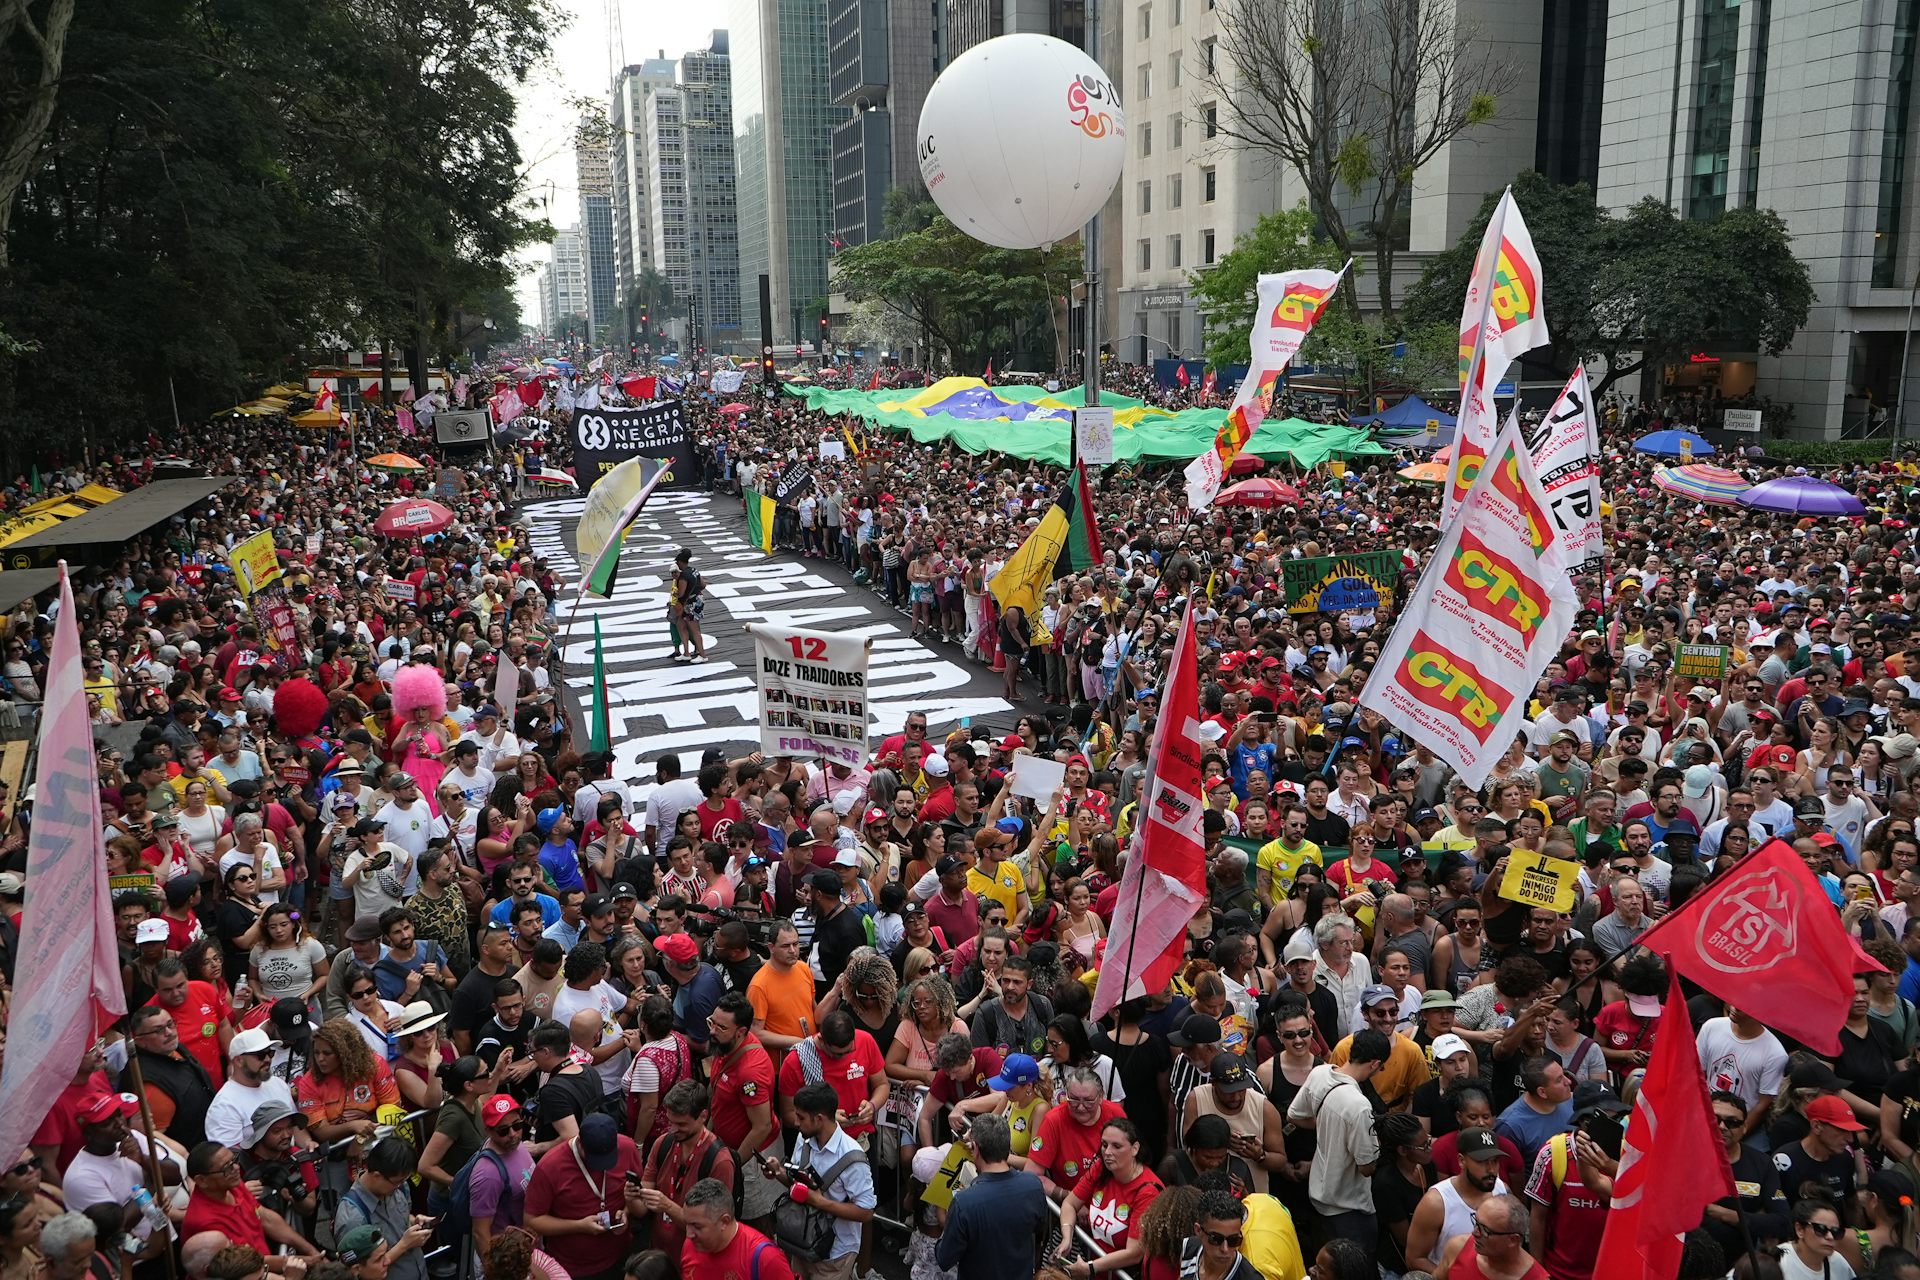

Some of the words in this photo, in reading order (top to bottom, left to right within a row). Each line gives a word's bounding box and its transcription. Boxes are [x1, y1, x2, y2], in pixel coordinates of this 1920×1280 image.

[611, 409, 680, 427] COALIZÃO
[1724, 420, 1755, 429] Corporate
[1728, 411, 1752, 421] Paulista
[613, 419, 684, 441] NEGRA
[615, 442, 636, 450] POR
[638, 434, 684, 449] DIREITOS
[1480, 491, 1513, 515] Central
[408, 508, 429, 518] CARLOS
[1285, 562, 1317, 583] SEM
[1328, 554, 1400, 579] ANISTIA
[388, 583, 413, 592] CARLOS
[1298, 580, 1328, 595] PRA
[1457, 549, 1541, 633] CTB
[1287, 598, 1308, 609] NÃO
[1323, 594, 1340, 607] PEC
[1343, 595, 1353, 604] DA
[1434, 589, 1468, 611] Central
[785, 635, 829, 662] 12
[1681, 655, 1720, 667] INIMIGO
[763, 657, 790, 678] DOZE
[794, 663, 864, 687] TRAIDORES
[1680, 665, 1692, 675] DO
[1694, 666, 1720, 677] POVO
[1407, 651, 1498, 728] CTB
[1385, 685, 1415, 709] Central
[1415, 706, 1431, 720] dos
[1389, 696, 1446, 740] Trabalhadoras
[1521, 879, 1556, 896] INIMIGO
[1523, 872, 1558, 886] CONGRESSO
[1519, 888, 1531, 898] DO
[1532, 892, 1555, 904] POVO
[1708, 931, 1753, 966] BRASIL
[1568, 1197, 1601, 1209] SHA
[1093, 1214, 1114, 1238] PT
